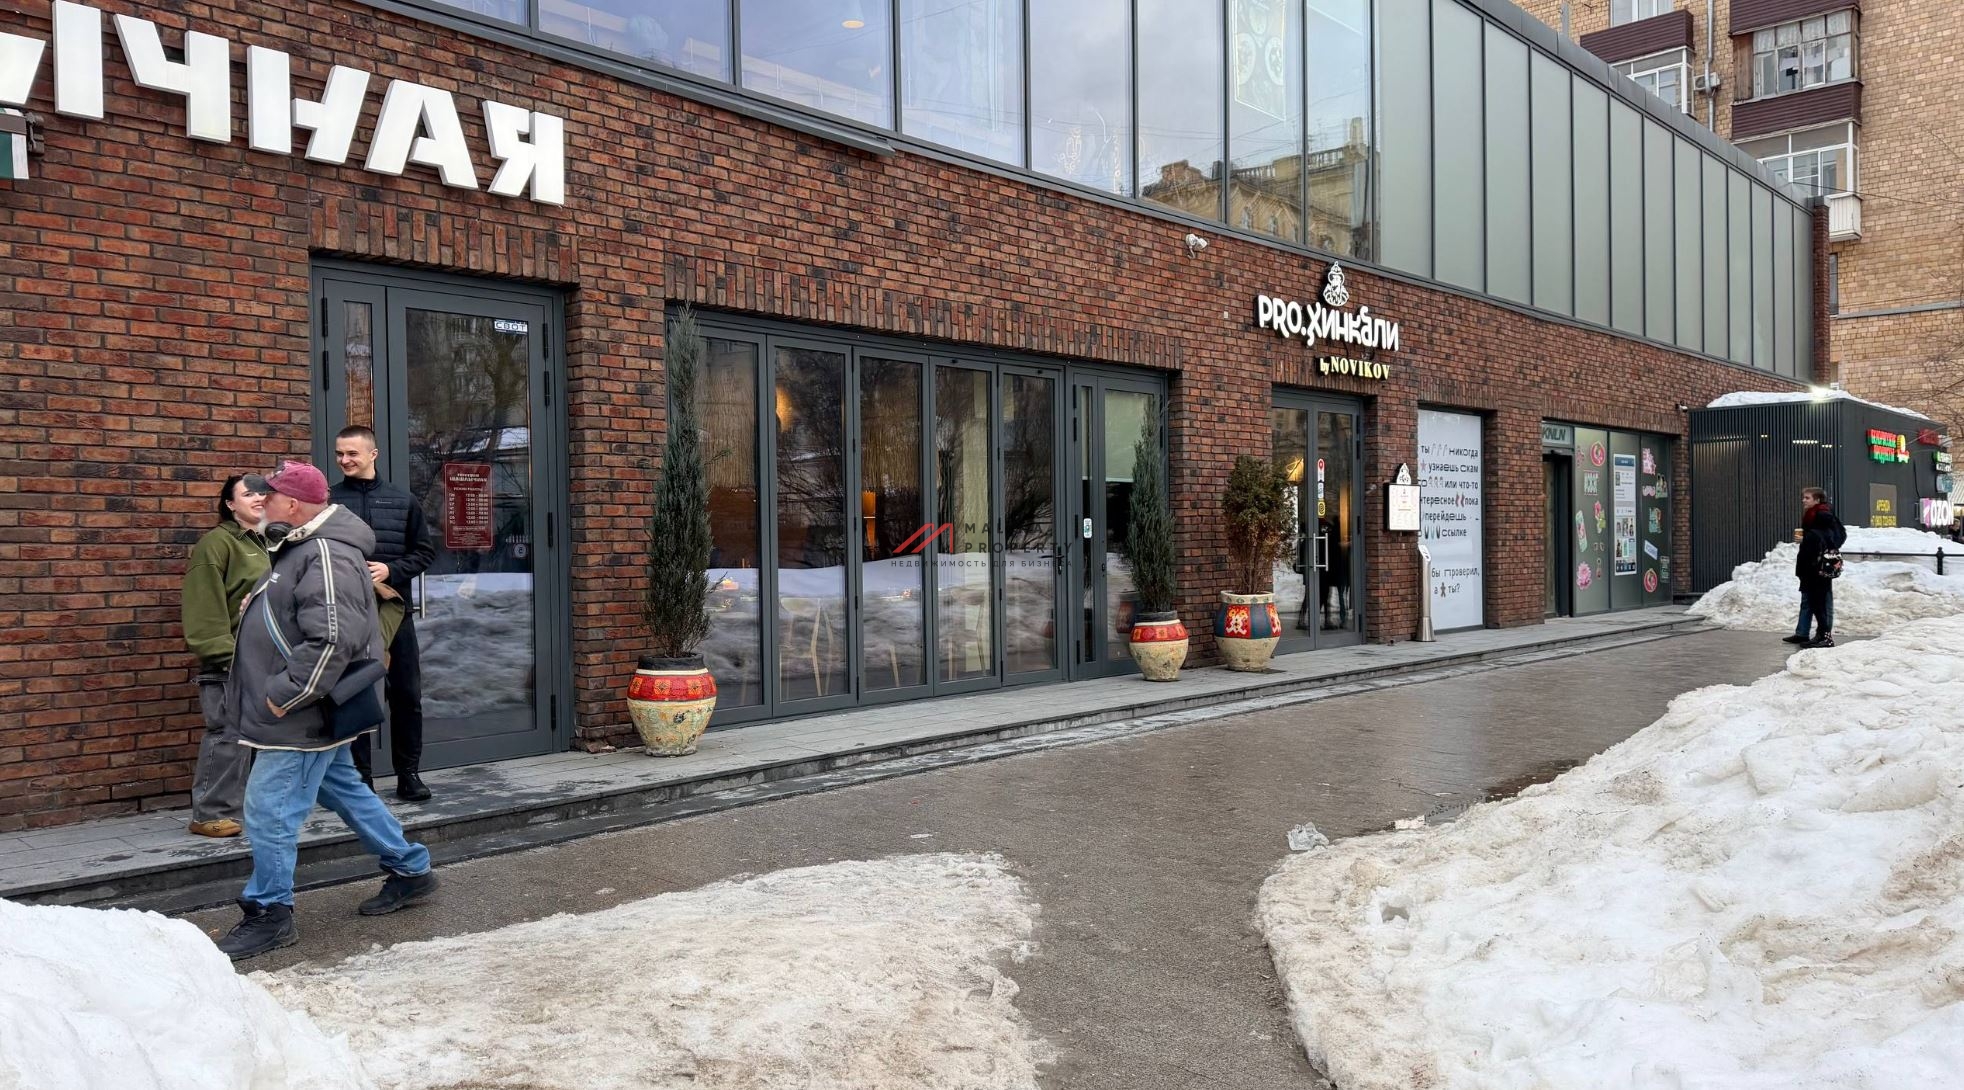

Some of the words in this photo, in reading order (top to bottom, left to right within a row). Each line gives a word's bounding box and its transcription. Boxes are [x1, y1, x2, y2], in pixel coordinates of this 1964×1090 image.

[1319, 357, 1330, 375] by
[1331, 356, 1391, 380] NOVIKOV
[1420, 445, 1430, 454] ты
[1448, 446, 1479, 460] никогда
[1428, 462, 1459, 473] узнаешь
[1459, 481, 1479, 490] что-то
[1464, 496, 1479, 505] пока
[1930, 498, 1954, 526] OZON
[1431, 567, 1441, 578] бы
[1433, 586, 1439, 595] а
[1447, 583, 1461, 594] ты?
